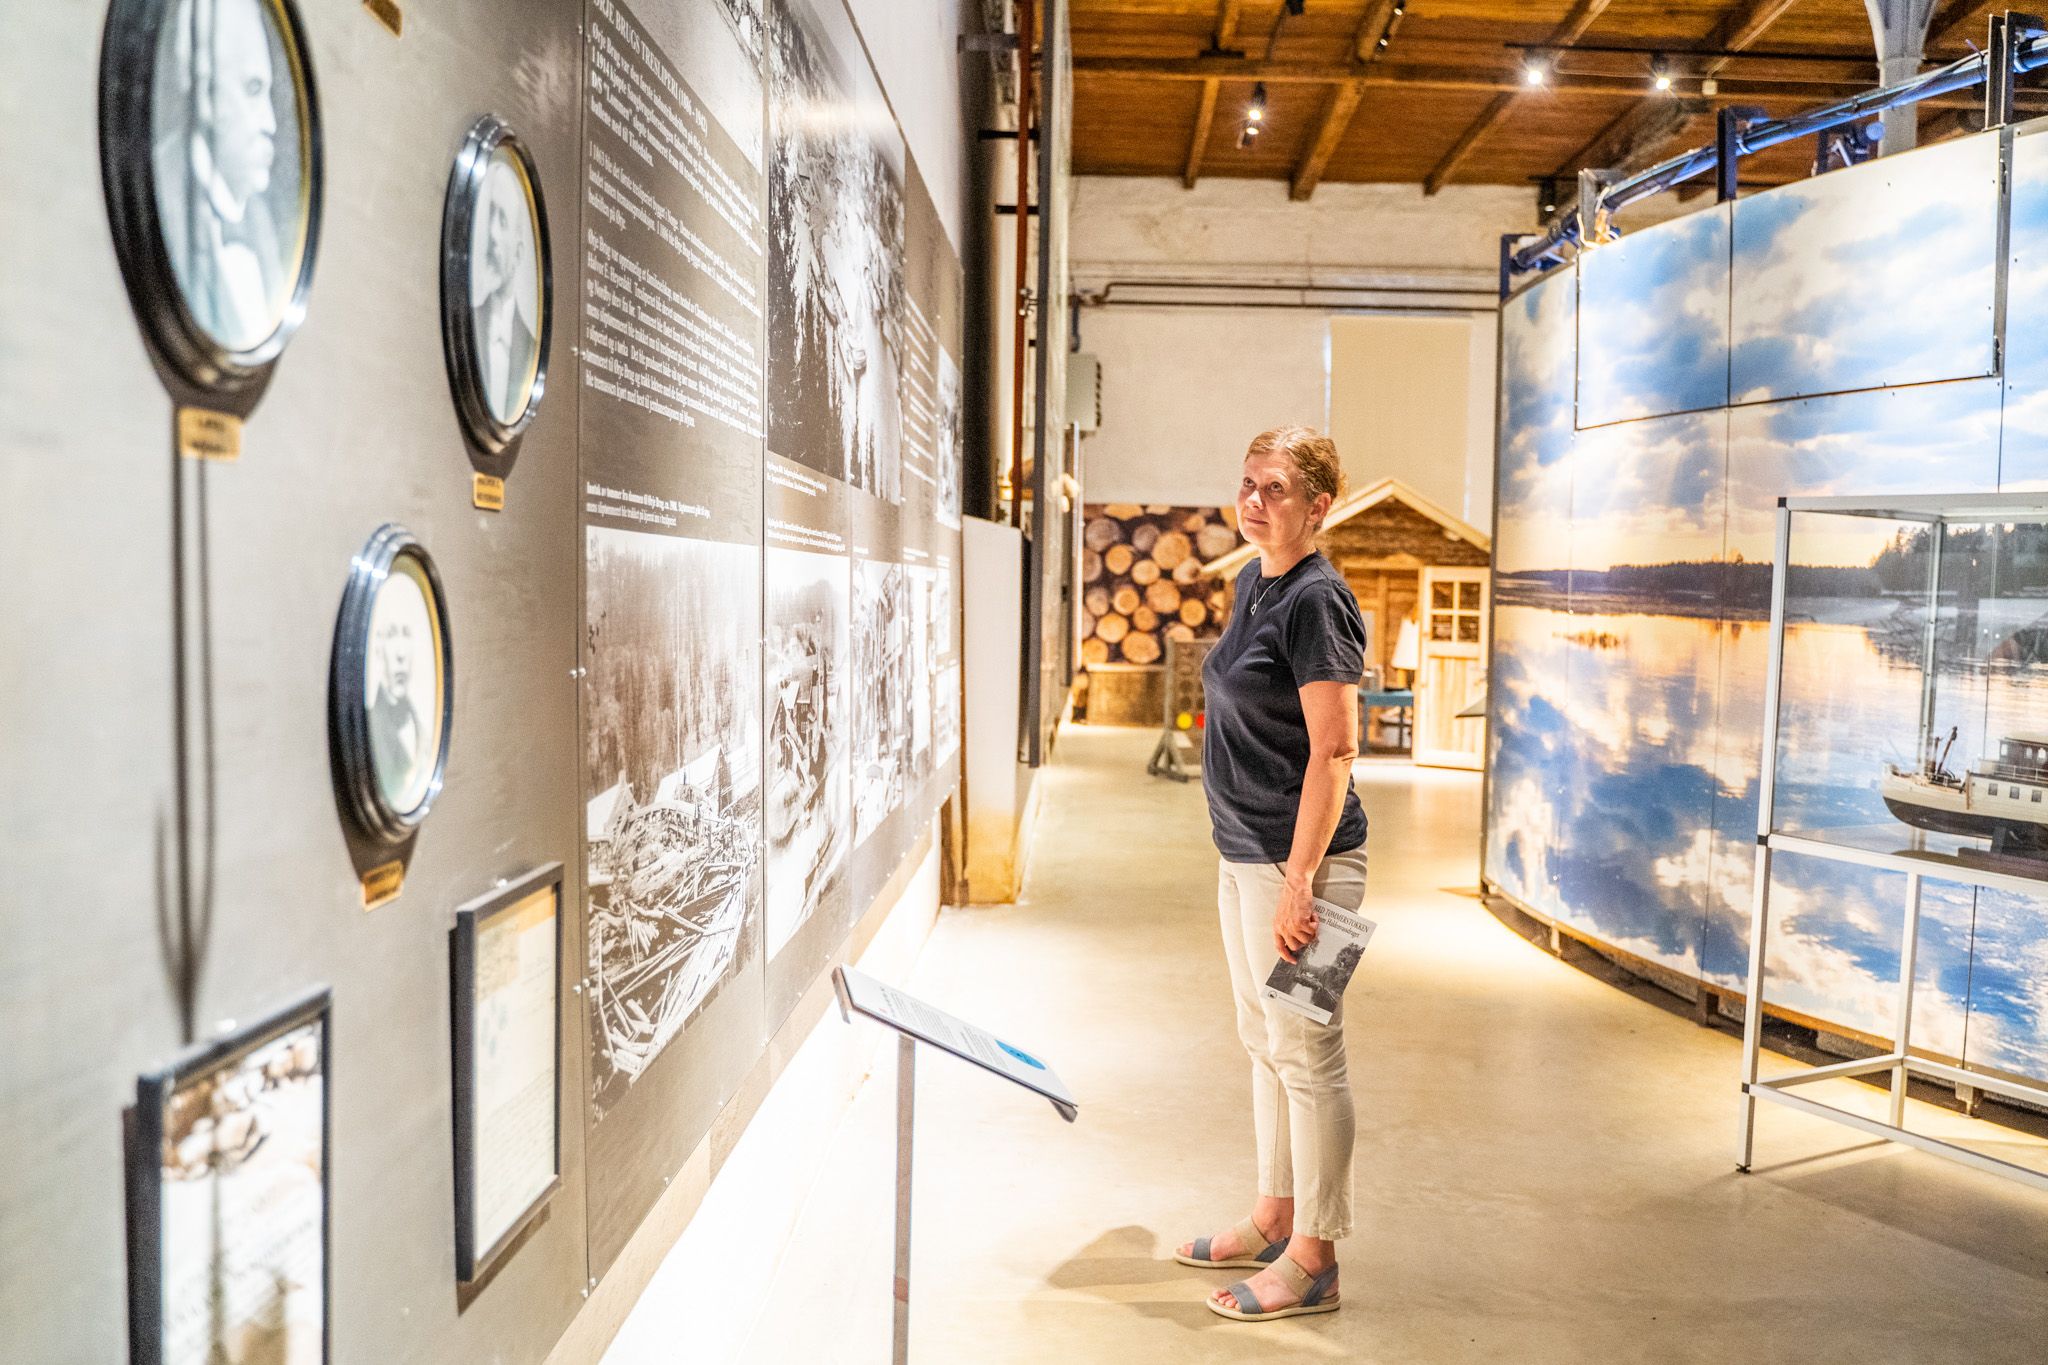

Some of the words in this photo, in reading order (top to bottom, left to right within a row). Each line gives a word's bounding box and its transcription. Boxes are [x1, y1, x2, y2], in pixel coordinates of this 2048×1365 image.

[592, 22, 606, 50] Ørje
[607, 37, 621, 68] Brug
[621, 57, 630, 74] var
[630, 65, 639, 85] den
[596, 51, 610, 76] 1914
[615, 10, 640, 54] BRUGS
[640, 40, 678, 100] TRESLIPERI
[611, 119, 622, 137] ned
